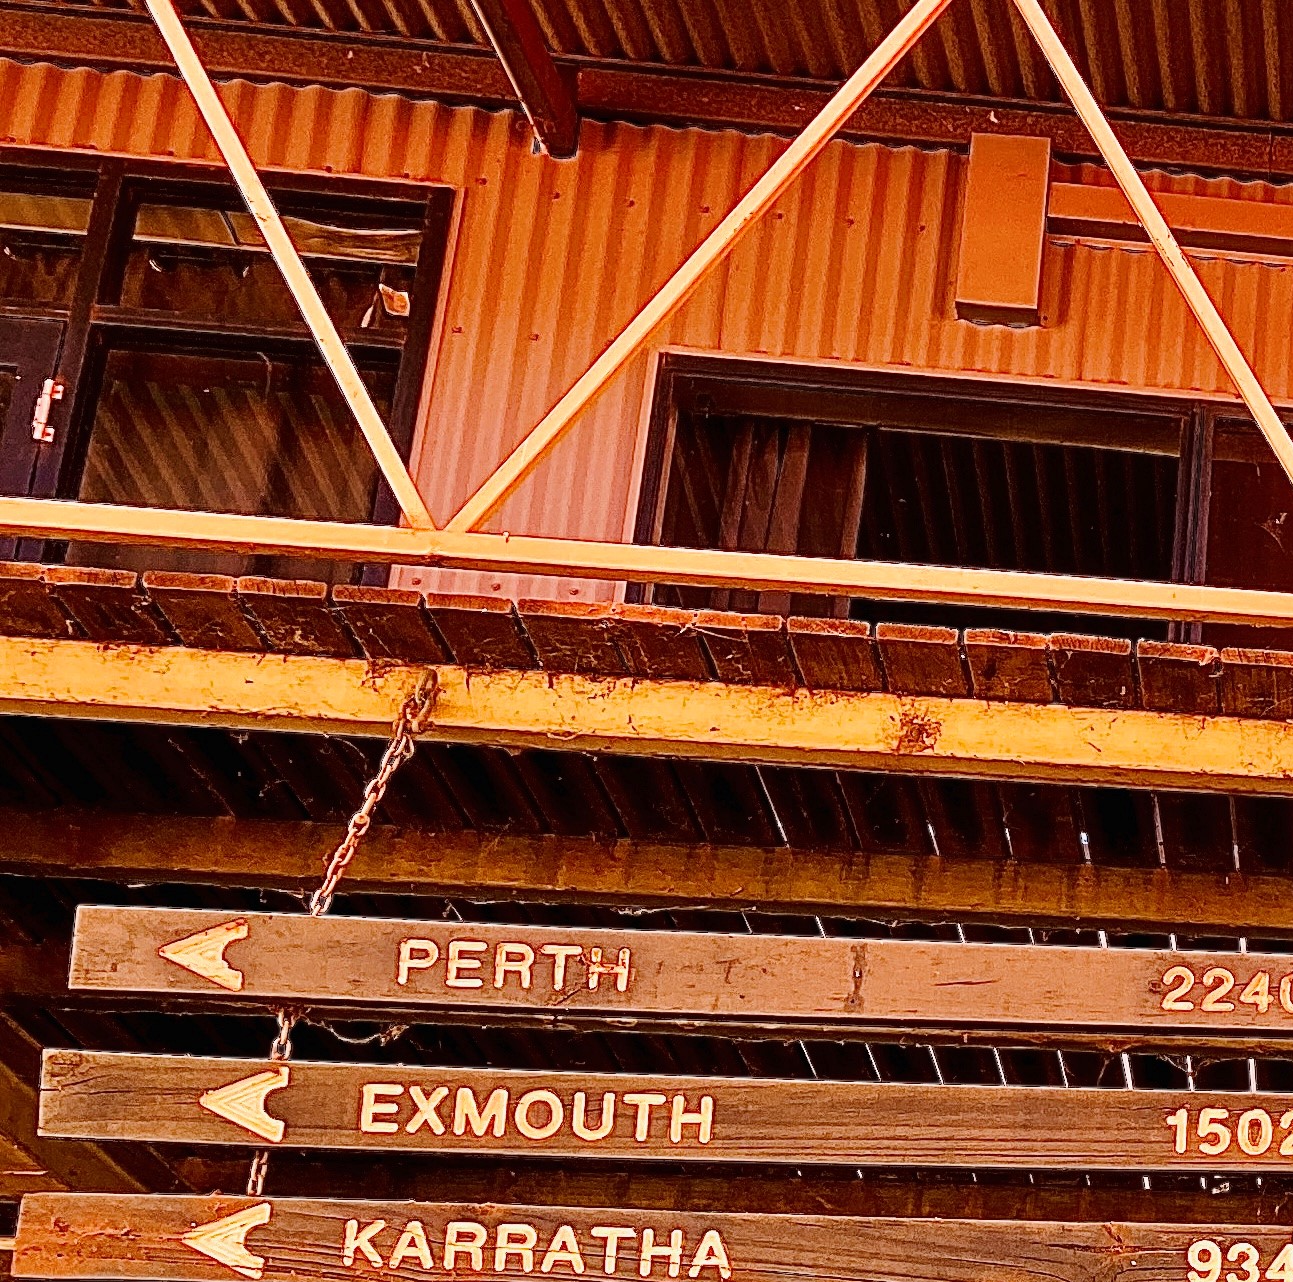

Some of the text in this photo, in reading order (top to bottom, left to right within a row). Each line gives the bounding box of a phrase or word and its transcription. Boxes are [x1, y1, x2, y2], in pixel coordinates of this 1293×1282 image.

[395, 937, 632, 994] PERTH
[358, 1081, 715, 1147] EXMOUTH
[340, 1217, 734, 1282] KARRATHA
